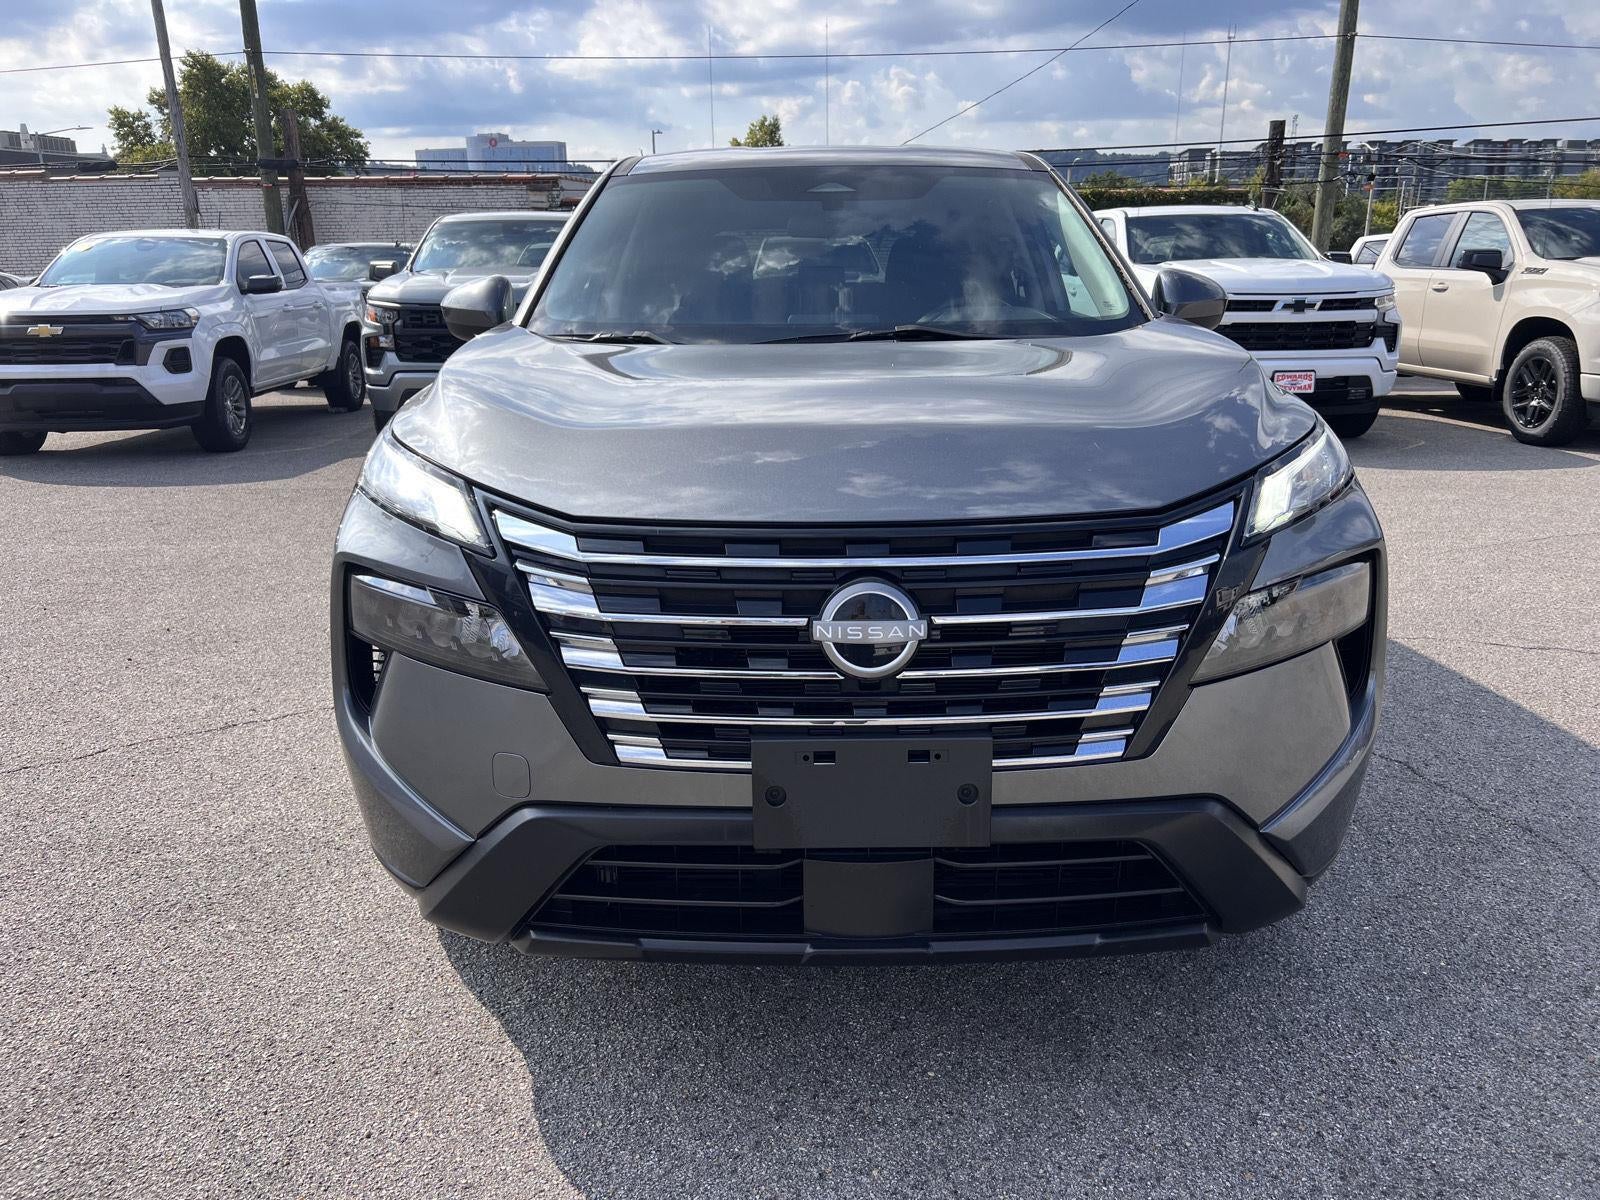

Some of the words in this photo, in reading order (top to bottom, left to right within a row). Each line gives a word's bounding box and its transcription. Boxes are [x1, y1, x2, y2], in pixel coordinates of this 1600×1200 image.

[1276, 374, 1313, 382] EDWARDS
[1279, 383, 1313, 391] EVYMAN
[816, 624, 924, 639] NISSAN
